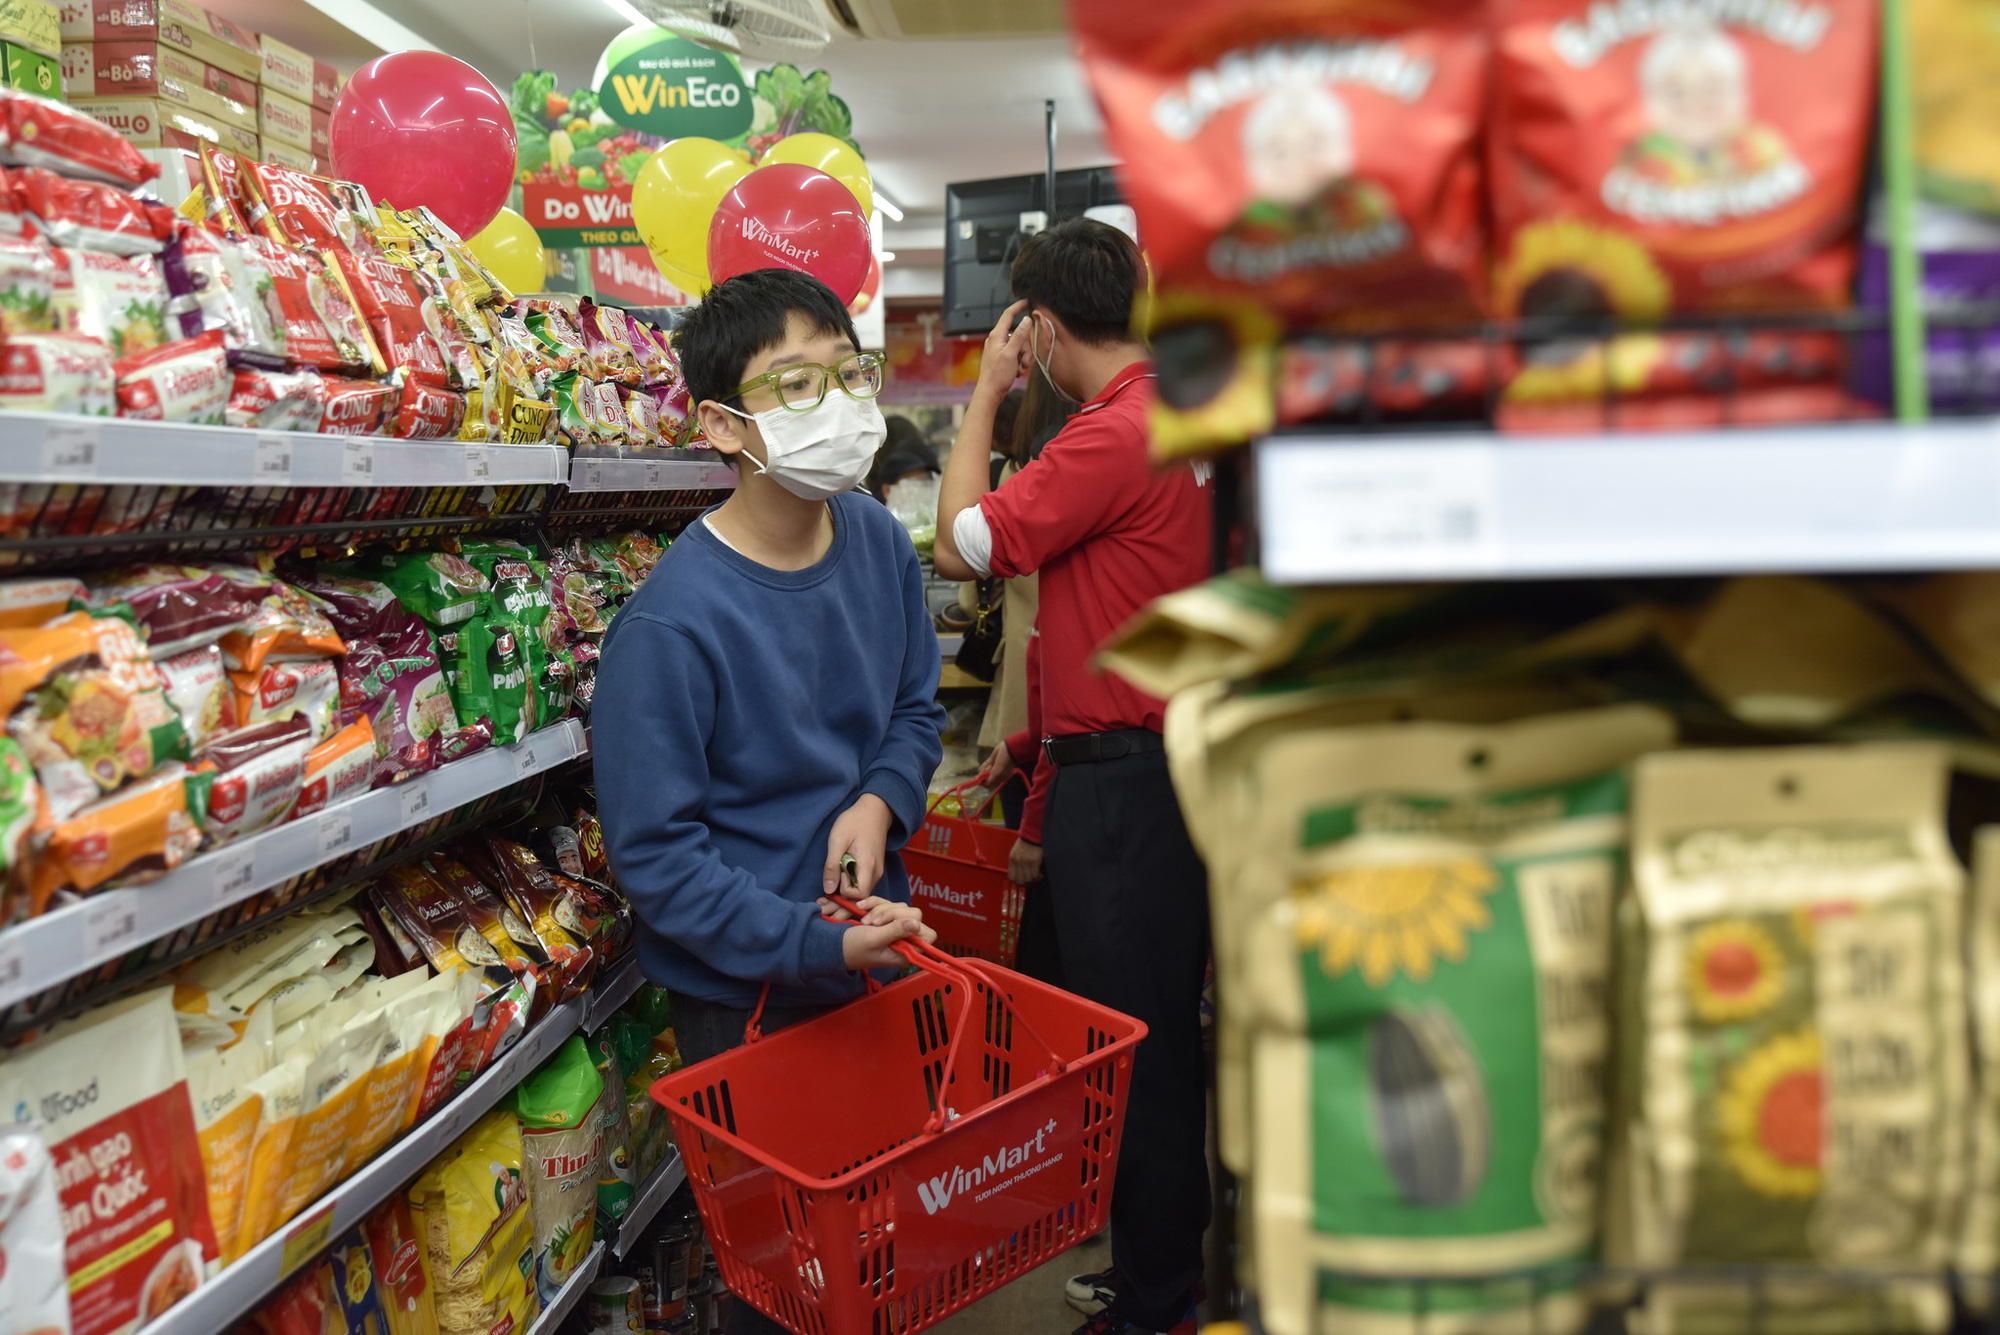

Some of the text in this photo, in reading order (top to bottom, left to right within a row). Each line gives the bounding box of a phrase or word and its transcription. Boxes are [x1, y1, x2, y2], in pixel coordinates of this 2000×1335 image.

[612, 73, 740, 115] WinEco
[544, 198, 580, 220] Do
[580, 231, 619, 244] THEO
[326, 395, 373, 421] CUNG
[416, 391, 448, 418] CUNG
[511, 403, 543, 427] CUNG
[917, 1117, 1058, 1216] WinMart+
[992, 1178, 1013, 1194] NGON
